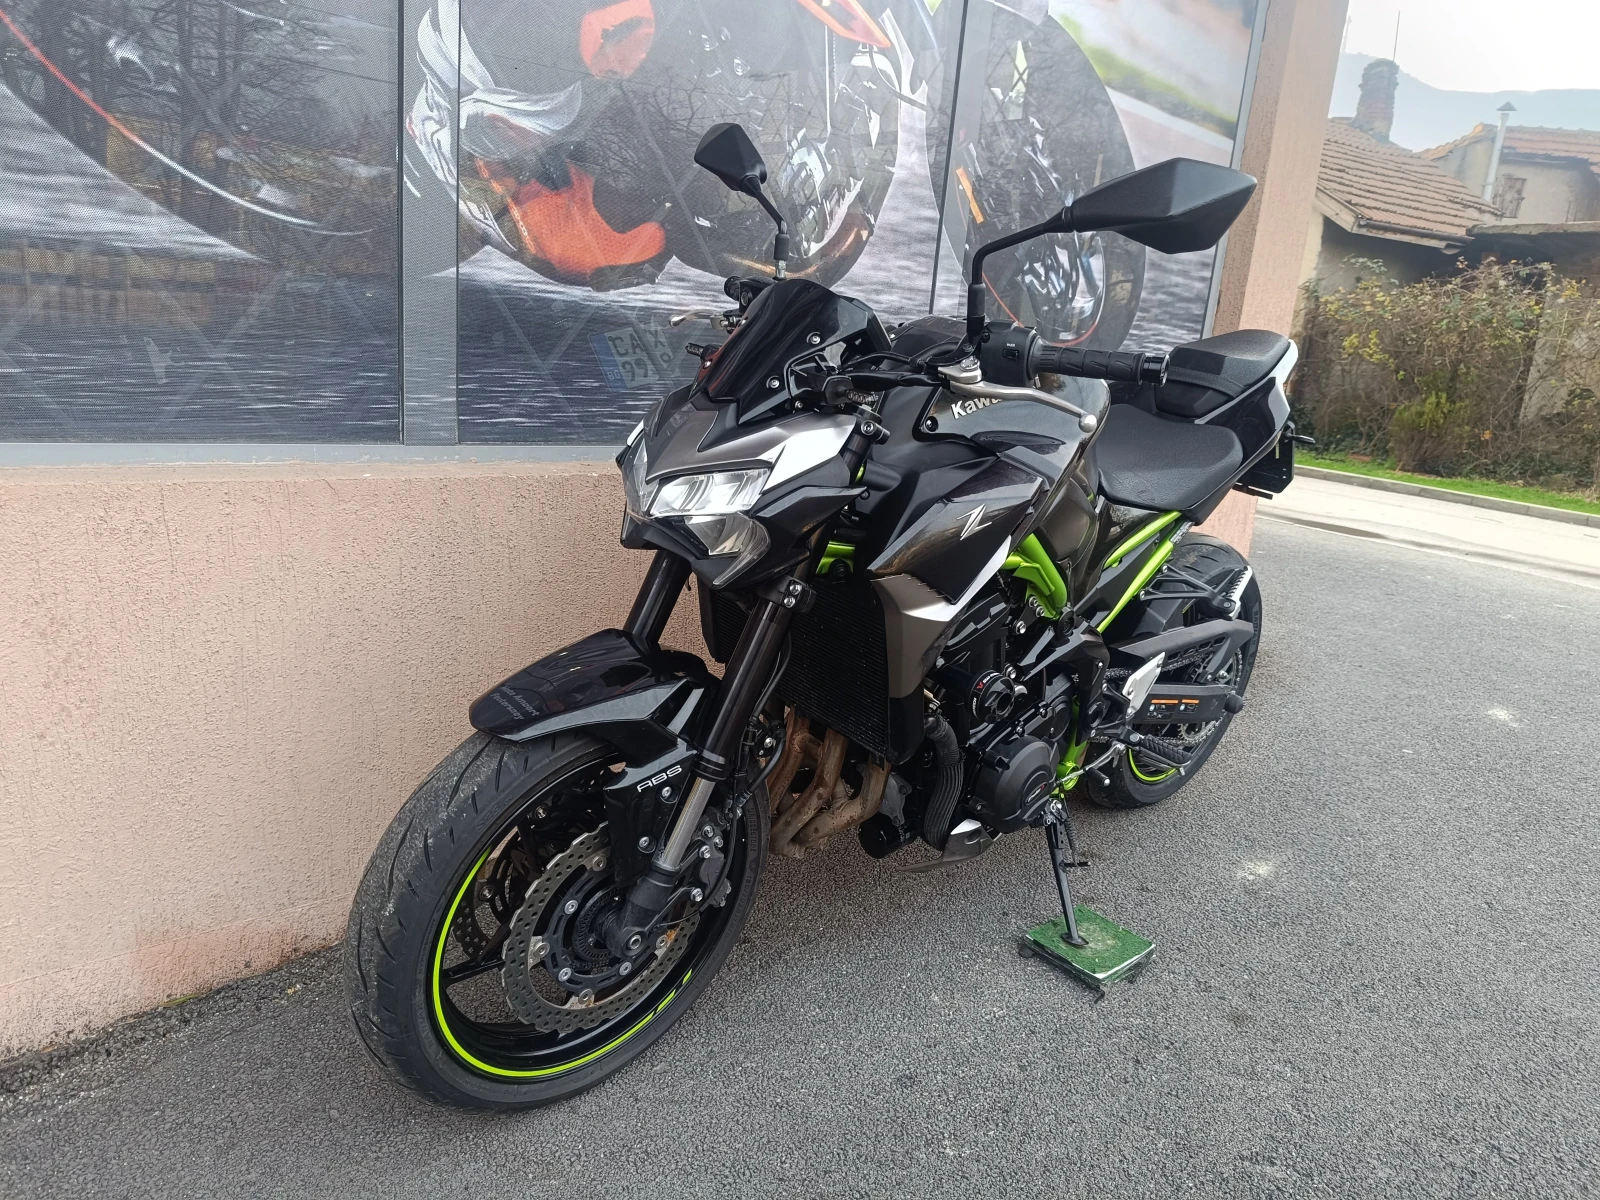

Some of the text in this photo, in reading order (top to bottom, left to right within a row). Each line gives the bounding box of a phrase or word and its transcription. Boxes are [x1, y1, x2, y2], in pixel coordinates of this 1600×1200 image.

[608, 333, 648, 357] CA
[607, 369, 621, 381] BG
[636, 765, 682, 793] ABS
